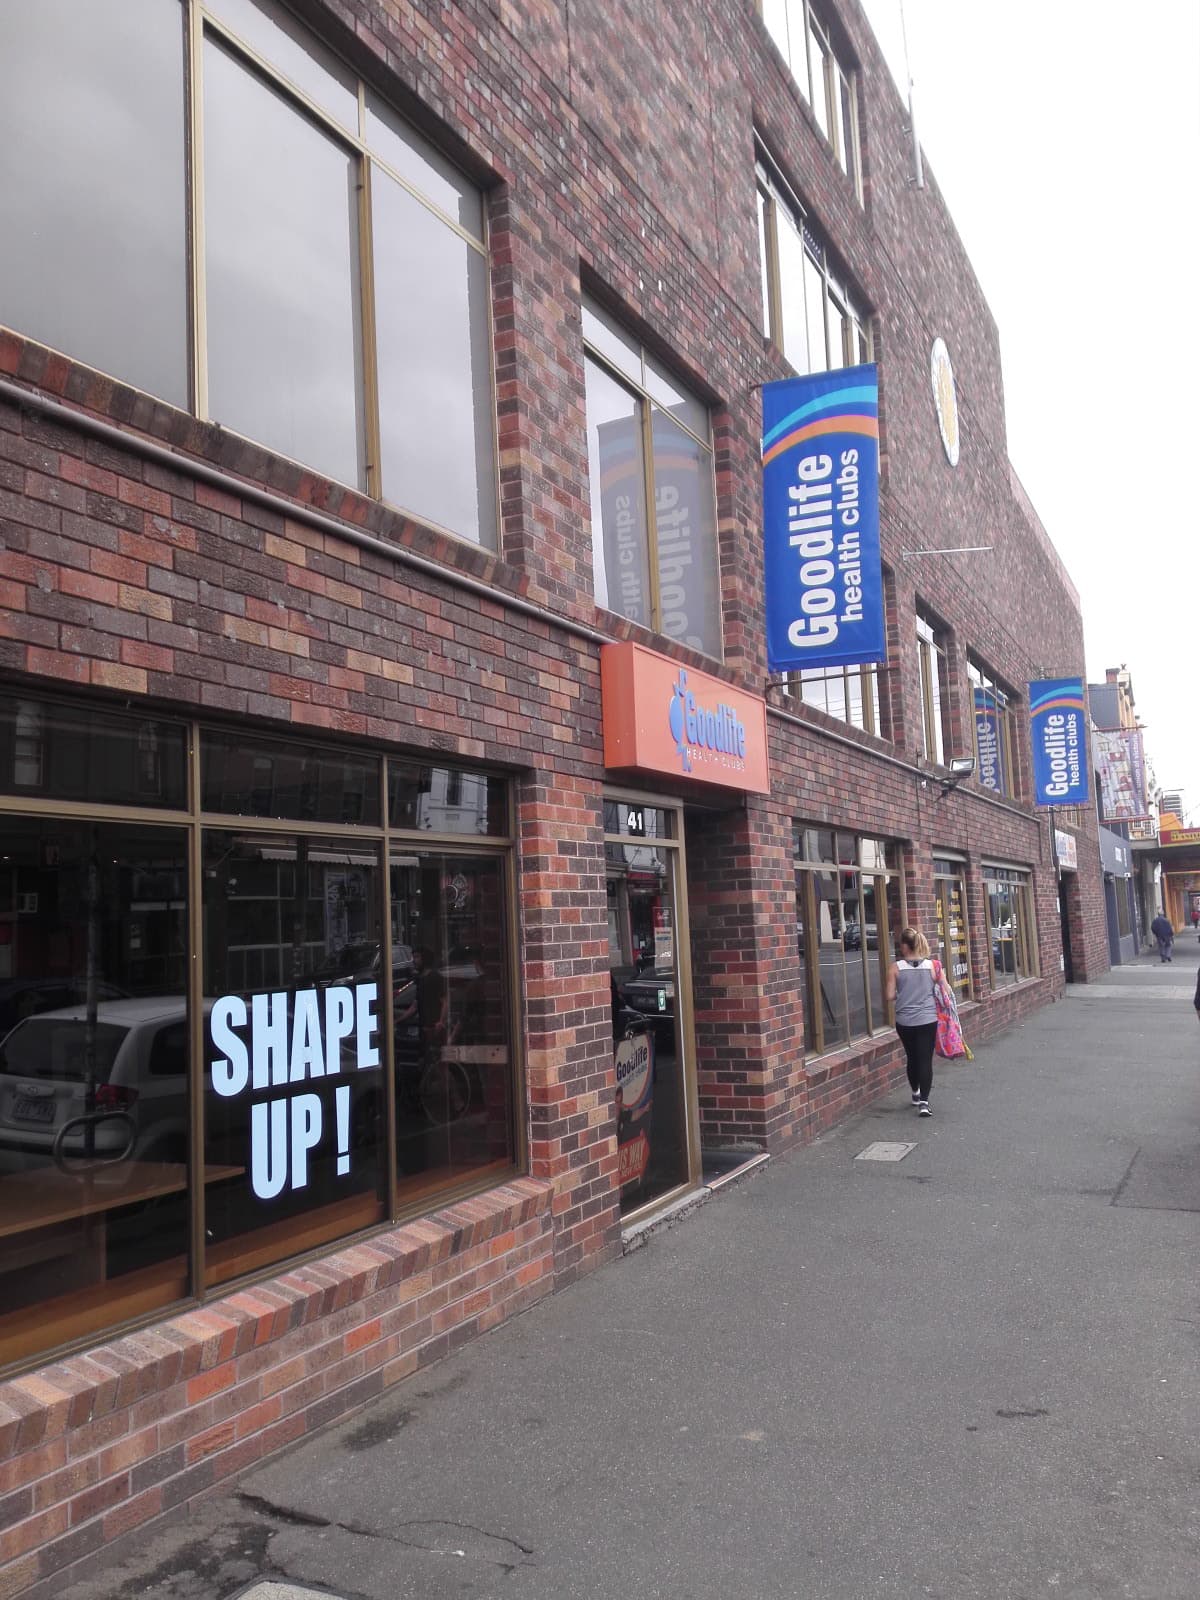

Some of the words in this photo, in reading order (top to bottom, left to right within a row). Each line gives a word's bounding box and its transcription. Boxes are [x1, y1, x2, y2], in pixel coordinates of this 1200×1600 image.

[836, 448, 860, 522] clubs
[788, 454, 839, 648] Goodlife
[837, 527, 864, 622] health
[684, 690, 747, 758] Goodlife
[1044, 714, 1069, 797] Goodlife
[1066, 713, 1077, 746] clubs
[1067, 751, 1080, 786] health
[627, 811, 643, 830] 41
[210, 983, 380, 1097] SHAPE
